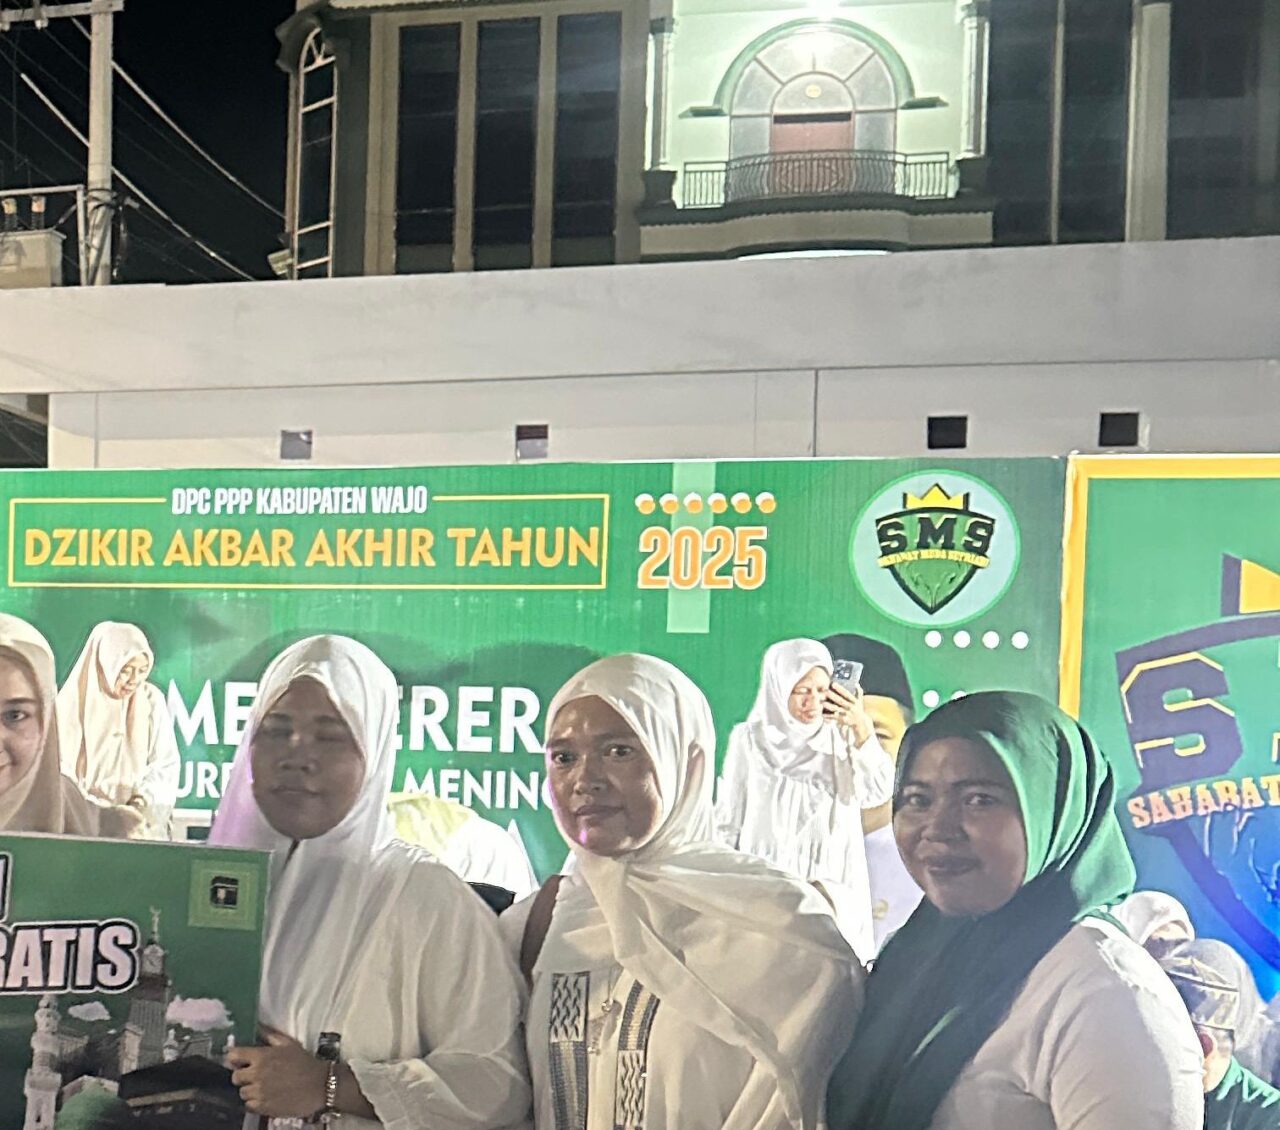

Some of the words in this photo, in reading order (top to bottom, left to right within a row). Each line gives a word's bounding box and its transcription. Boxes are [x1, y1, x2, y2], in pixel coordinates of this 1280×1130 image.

[171, 487, 211, 515] DPC
[214, 487, 253, 515] PPP
[256, 486, 367, 515] KABUPATEN
[371, 485, 428, 514] WAJO
[24, 528, 155, 567] DZIKIR
[162, 528, 296, 567] AKBAR
[304, 528, 437, 567] AKHIR
[447, 526, 599, 567] TAHUN
[877, 514, 995, 557] SMS
[637, 525, 768, 590] 2025
